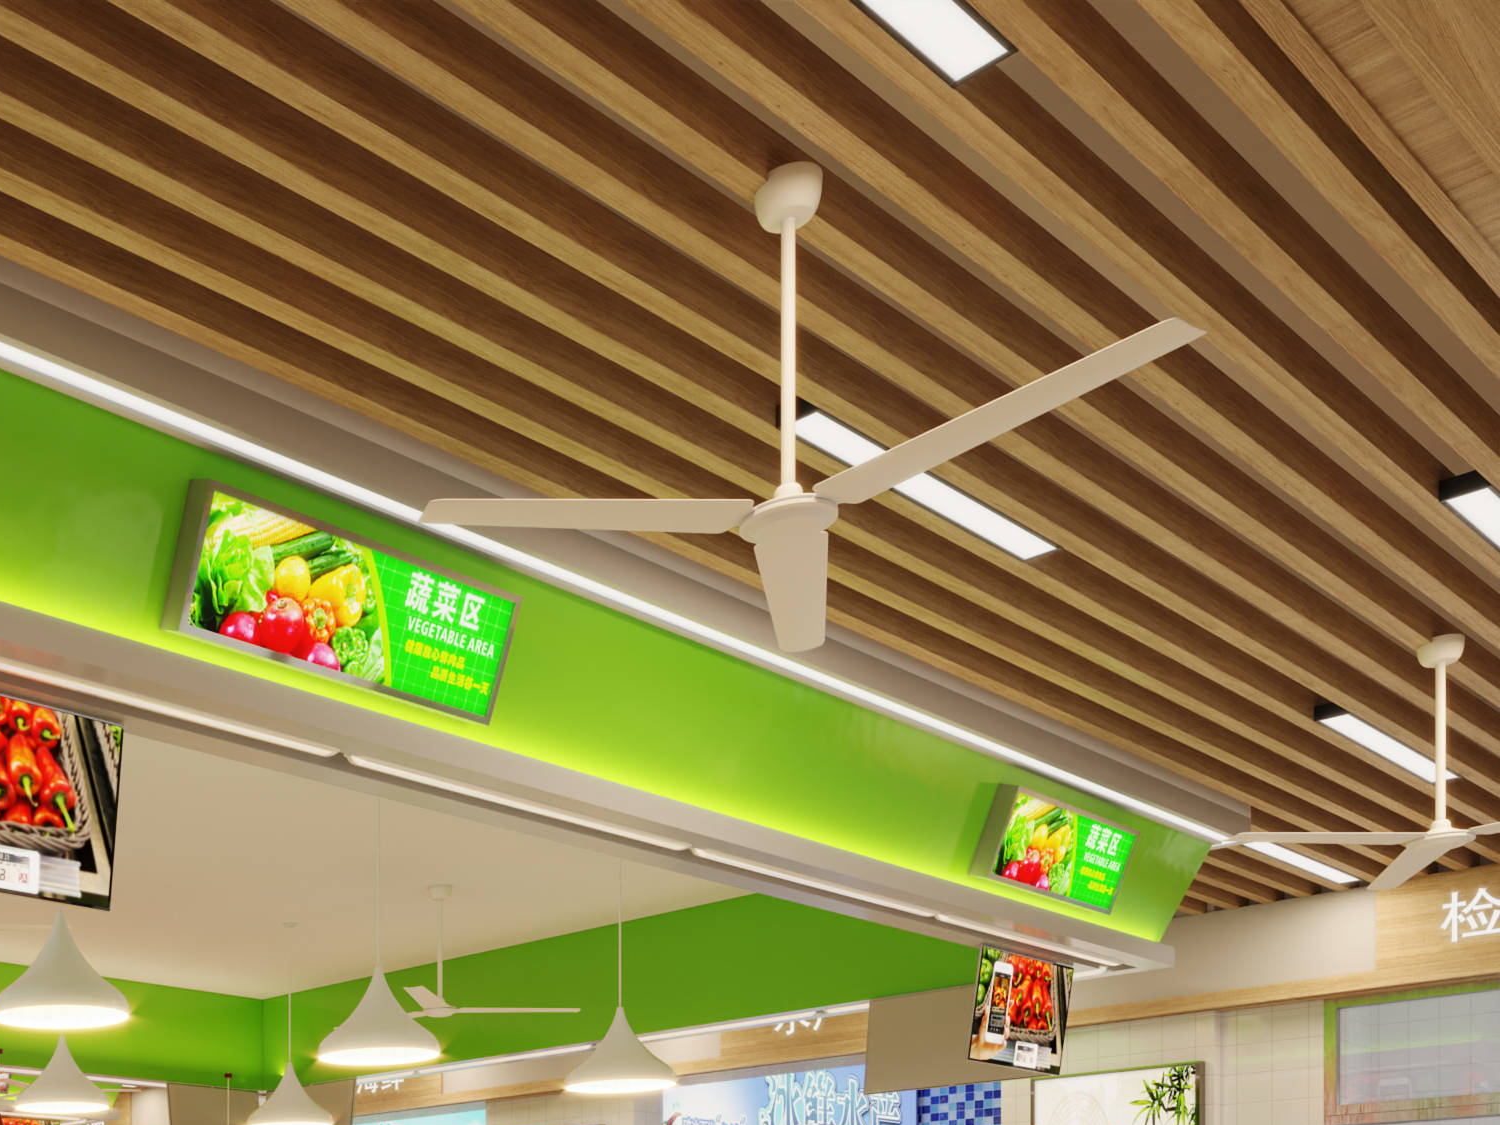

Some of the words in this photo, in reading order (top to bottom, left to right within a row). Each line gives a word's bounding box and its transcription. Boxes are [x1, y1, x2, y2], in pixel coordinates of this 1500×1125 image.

[404, 572, 485, 631] 蔬菜区
[408, 616, 467, 648] VEGETABLE
[467, 637, 494, 658] AREA
[1085, 824, 1122, 856] 蔬菜区
[1441, 887, 1500, 943] 检
